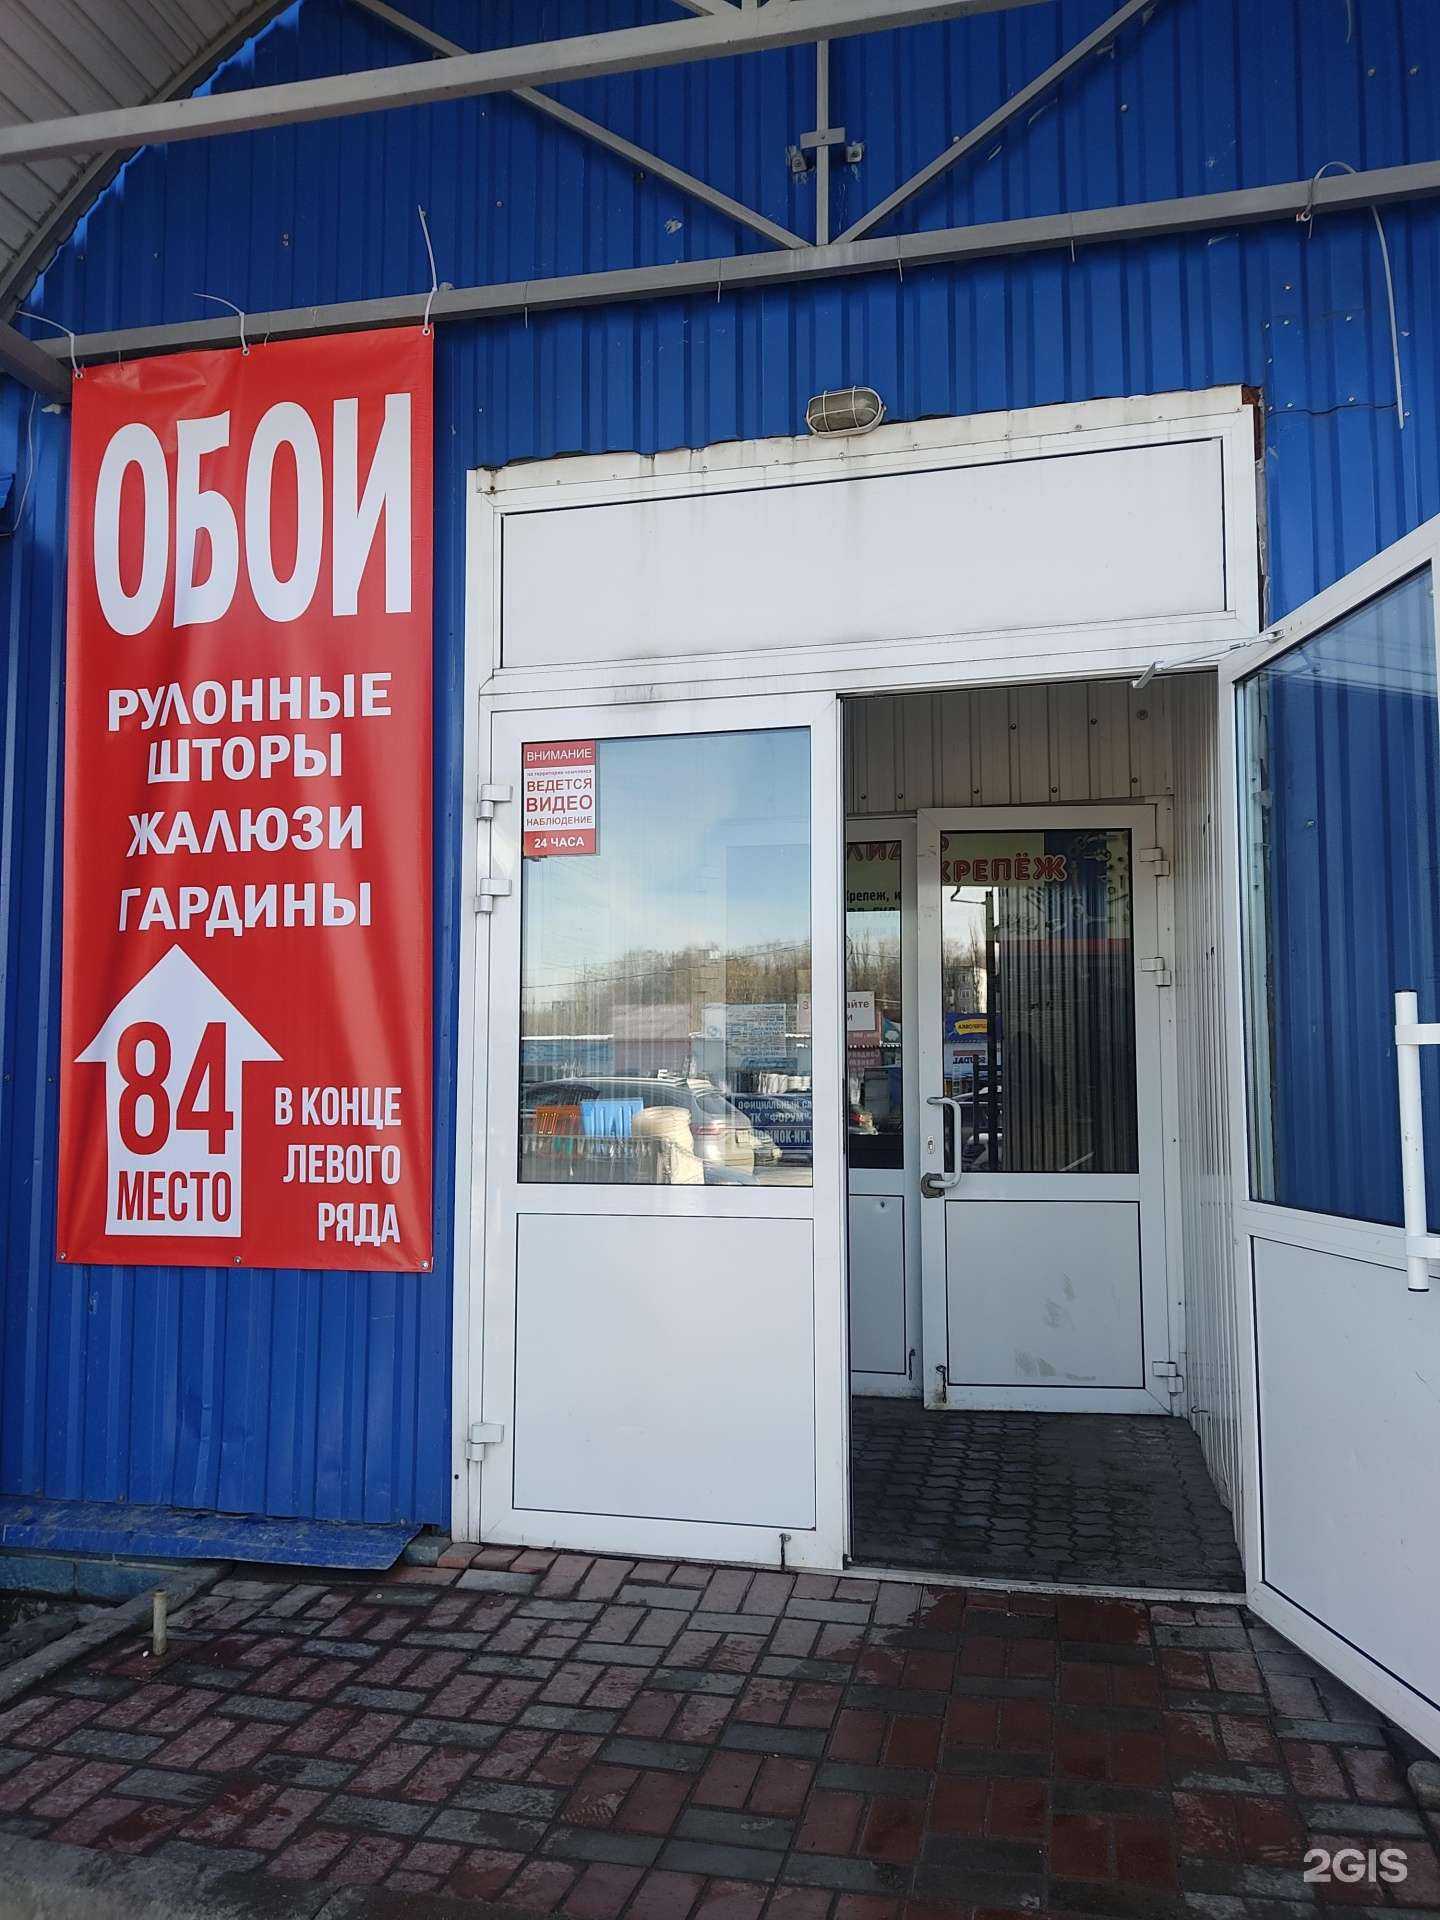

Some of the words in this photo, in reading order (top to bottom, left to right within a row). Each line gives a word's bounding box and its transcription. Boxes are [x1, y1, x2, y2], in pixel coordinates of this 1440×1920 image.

[93, 392, 412, 636] ОБОИ
[108, 672, 392, 732] РУЛОННЫЕ
[147, 733, 343, 784] ШТОРЫ
[526, 747, 593, 762] ВНИМАНИЕ
[526, 794, 593, 815] ВИДЕО
[527, 777, 592, 793] ВЕДЕТСЯ
[126, 805, 363, 857] ЖАЛЮЗИ
[526, 815, 593, 827] НАБЛЮДЕНИЕ
[534, 838, 548, 849] 24
[550, 836, 585, 848] ЧАСА
[118, 882, 372, 937] ГАРДИНЫ
[116, 1021, 234, 1156] 84
[275, 1088, 292, 1126] В
[301, 1087, 402, 1131] КОНЦЕ
[282, 1144, 400, 1184] ЛЕВОГО
[116, 1170, 232, 1222] МЕСТО
[318, 1202, 400, 1246] РЯДА
